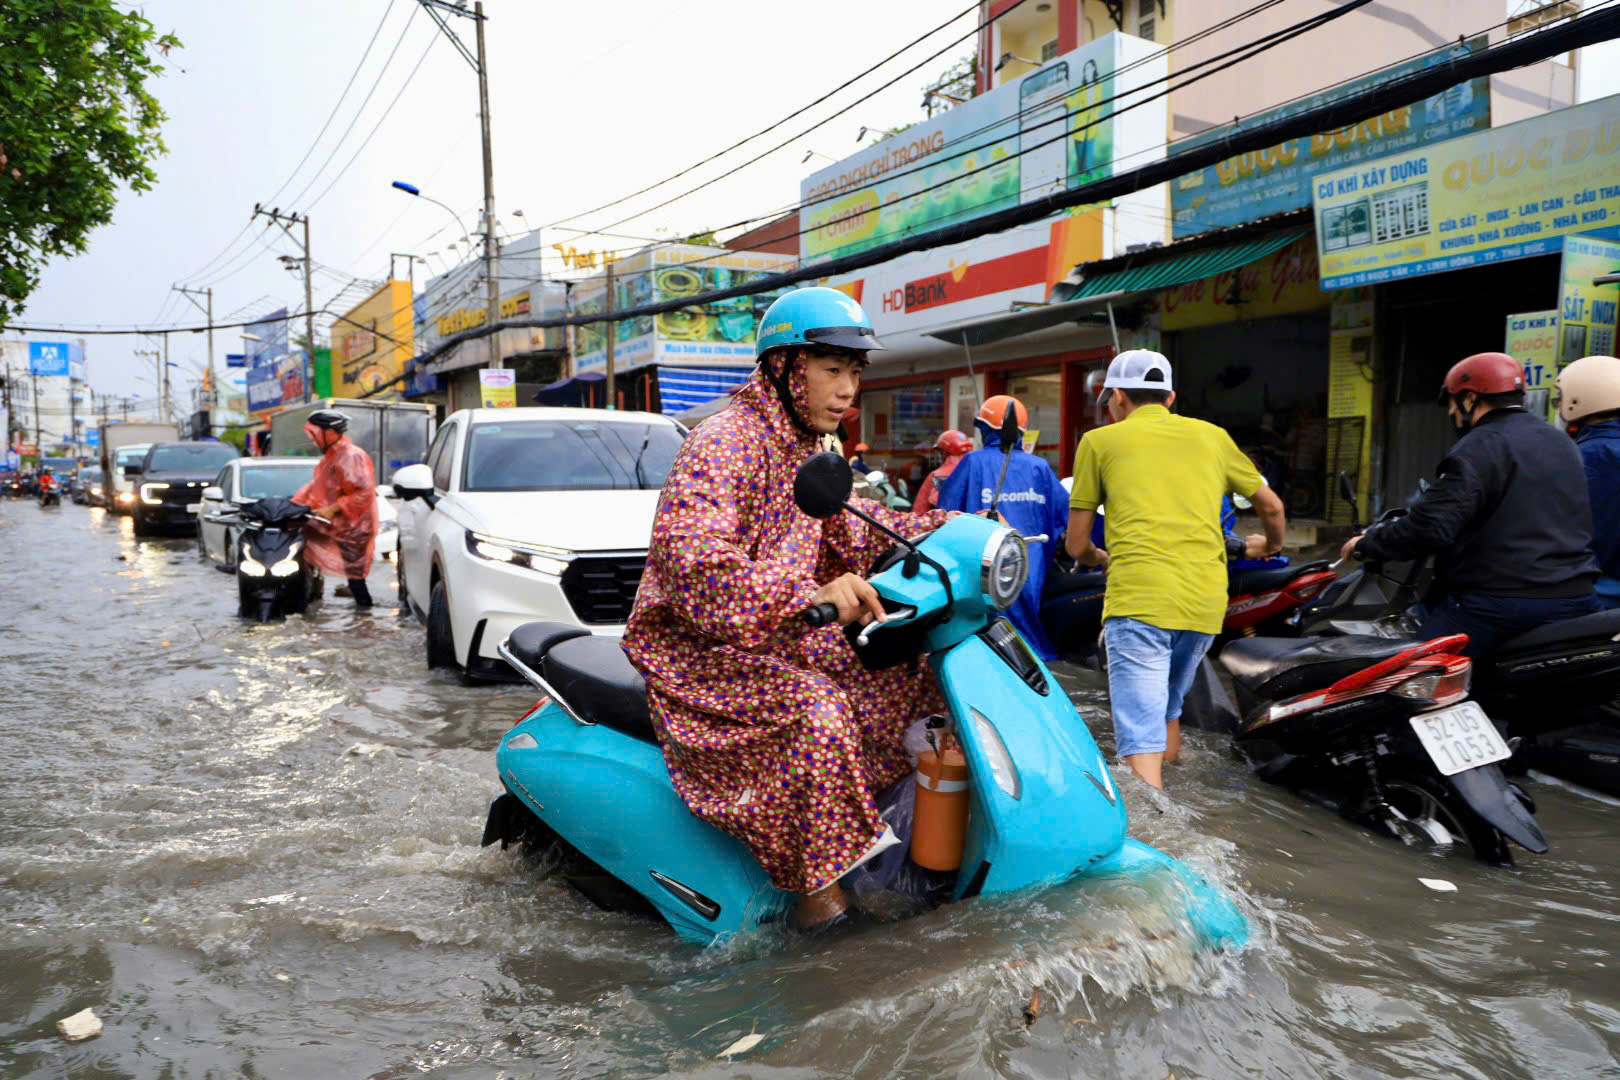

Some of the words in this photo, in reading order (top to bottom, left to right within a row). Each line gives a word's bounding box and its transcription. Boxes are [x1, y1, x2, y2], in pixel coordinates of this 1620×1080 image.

[891, 131, 945, 168] TRONG
[1318, 180, 1334, 199] CƠ
[1338, 172, 1358, 195] KHÍ
[1362, 166, 1386, 189] XÂY
[1390, 157, 1428, 183] DỰNG
[1519, 203, 1539, 217] LAN
[1541, 197, 1564, 212] CAN
[1582, 208, 1607, 224] KHO
[883, 277, 947, 314] HDBank
[1512, 317, 1526, 330] CƠ
[1528, 315, 1546, 328] KHÍ
[1523, 357, 1544, 386] ẮT
[1441, 733, 1496, 767] 1053
